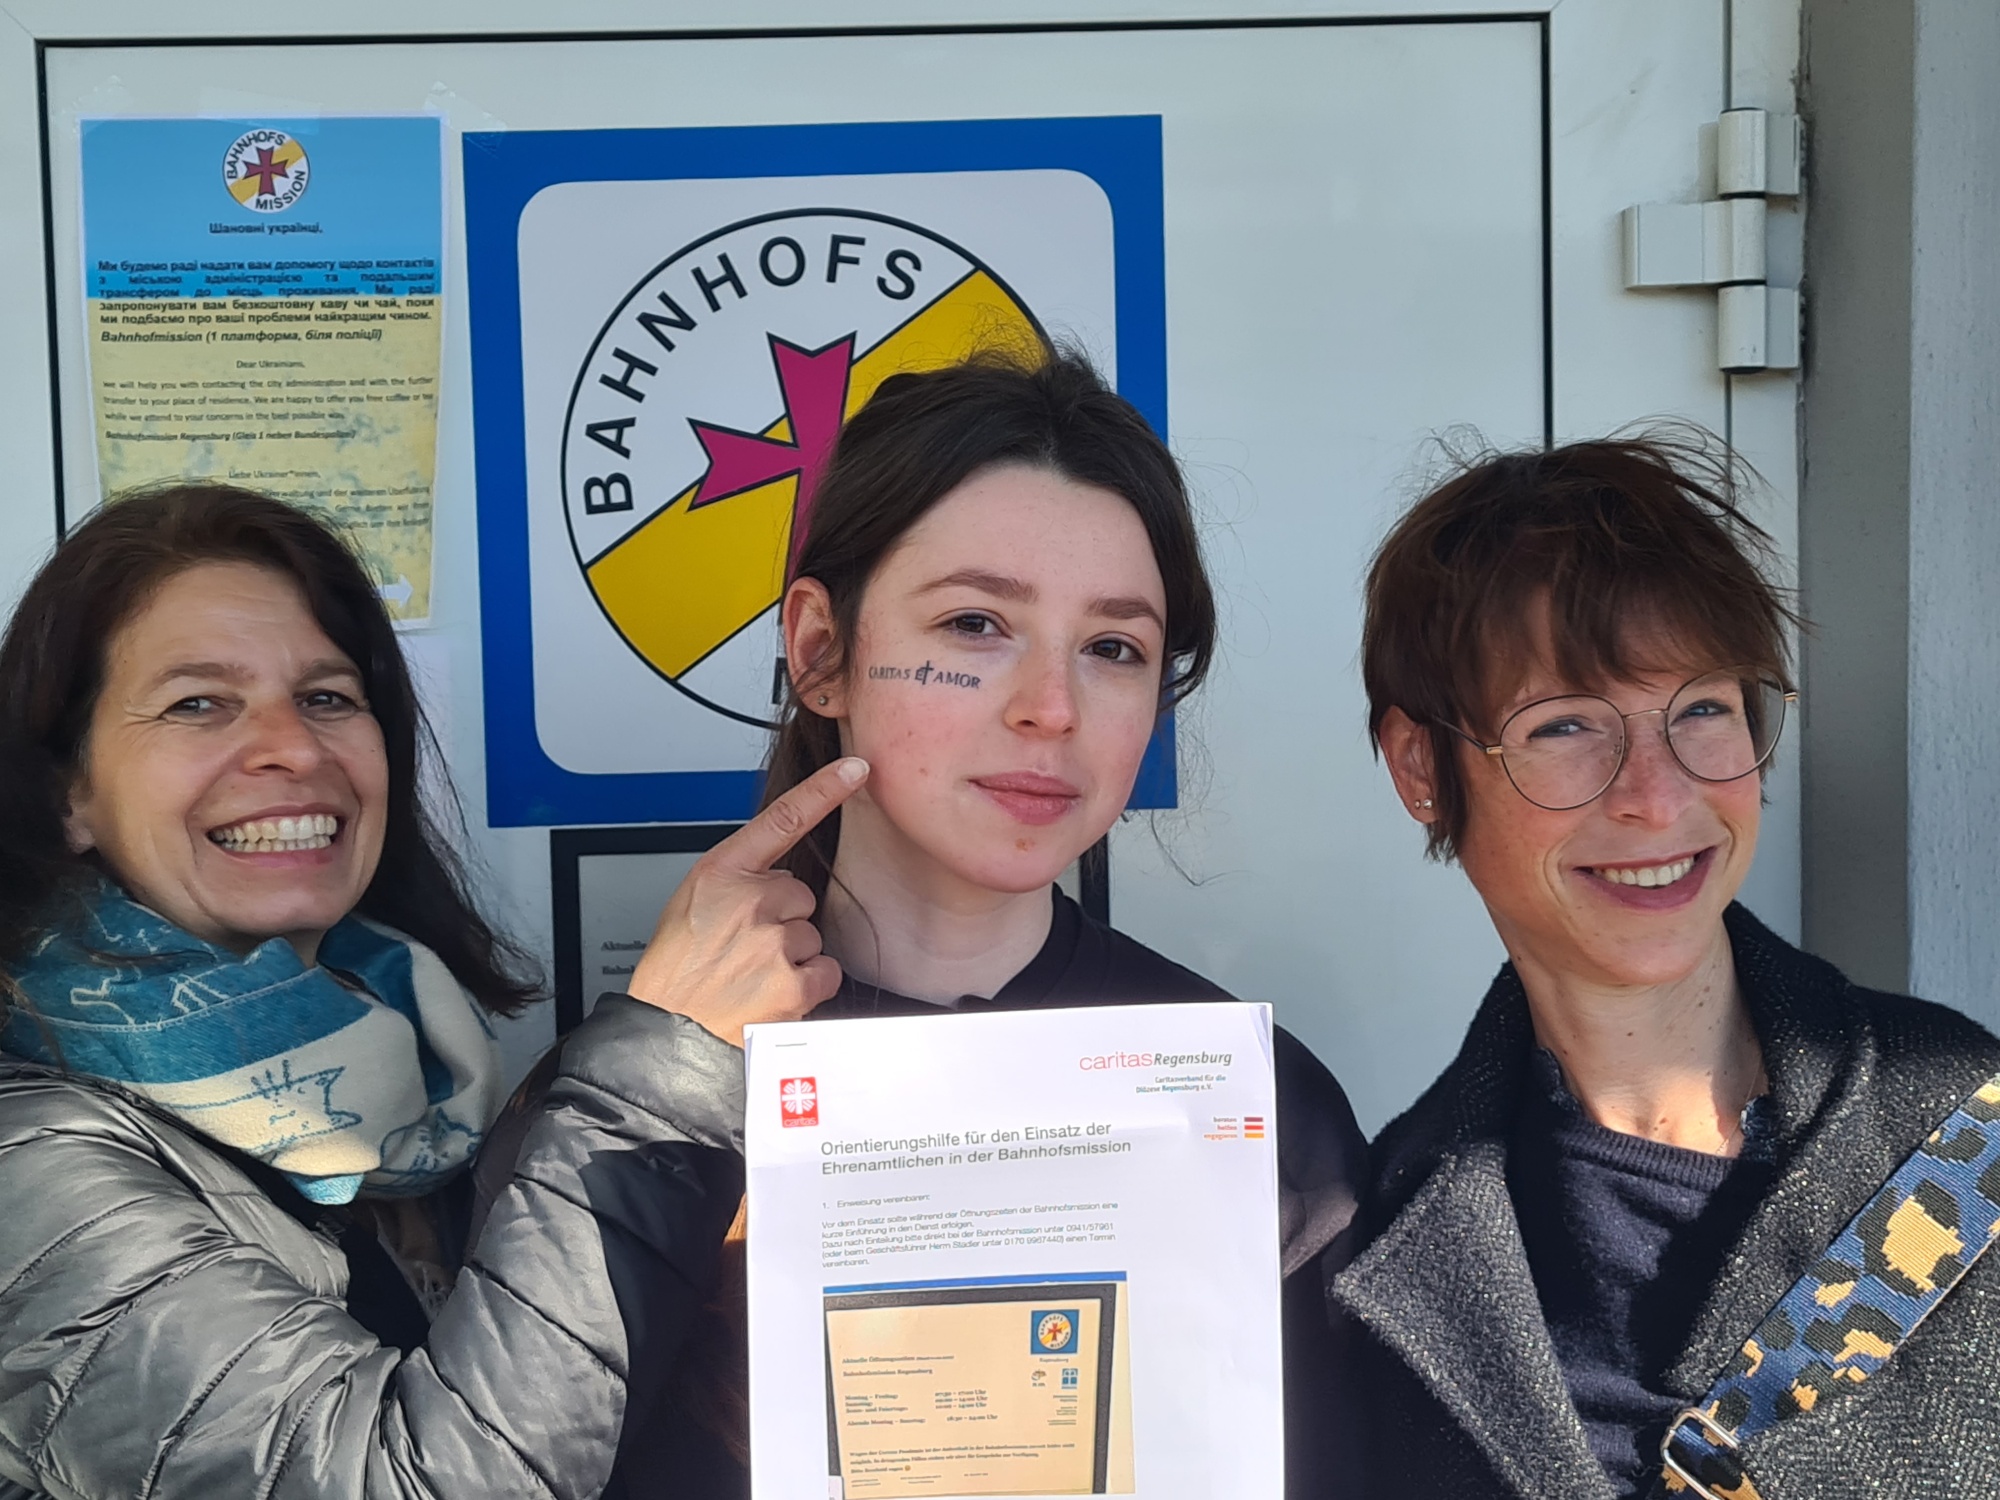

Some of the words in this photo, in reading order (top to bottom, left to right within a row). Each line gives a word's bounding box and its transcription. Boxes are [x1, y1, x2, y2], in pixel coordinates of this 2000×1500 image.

[227, 131, 285, 179] BAHNHOFS
[255, 170, 306, 210] MISSION
[209, 223, 265, 234] Шановні
[121, 260, 167, 273] будемо
[171, 260, 198, 272] раді
[201, 261, 244, 270] надати
[248, 261, 271, 270] вам
[275, 260, 336, 271] допомогу
[376, 257, 435, 268] контактів
[194, 289, 211, 298] до
[99, 301, 197, 313] запропонувати
[203, 301, 227, 310] вам
[232, 299, 314, 311] безкоштовну
[321, 300, 349, 311] каву
[354, 299, 369, 308] чи
[375, 298, 400, 309] чай,
[406, 298, 435, 307] поки
[100, 315, 117, 323] ми
[189, 315, 212, 325] про
[215, 313, 245, 323] ваші
[248, 313, 311, 325] проблеми
[314, 311, 386, 323] найкращим
[389, 311, 431, 321] чином.
[101, 330, 203, 342] Bahnhofmission
[206, 331, 217, 344] (1
[221, 330, 301, 343] платформа,
[305, 329, 332, 340] біля
[336, 328, 382, 341] поліції)
[236, 360, 256, 369] Dear
[584, 234, 923, 515] BAHNHOFS
[137, 381, 157, 390] help
[161, 382, 177, 390] you
[202, 380, 246, 390] contacting
[249, 380, 263, 388] the
[286, 379, 346, 387] administration
[350, 378, 365, 386] and
[139, 397, 148, 405] to
[151, 398, 170, 407] your
[180, 432, 230, 442] Regensburg
[868, 666, 911, 680] CARITAS
[933, 671, 982, 689] AMOR
[1155, 1075, 1204, 1084] Caritasverband
[1215, 1074, 1227, 1082] die
[1162, 1084, 1200, 1093] Regensburg
[821, 1132, 960, 1155] Orientierungshilfe
[964, 1131, 986, 1145] für
[990, 1129, 1020, 1143] den
[1025, 1124, 1082, 1141] Einsatz
[1086, 1122, 1112, 1136] der
[822, 1155, 944, 1175] Ehrenamtlichen
[948, 1152, 962, 1165] in
[967, 1150, 994, 1163] der
[998, 1140, 1131, 1161] Bahnhofsmission
[837, 1198, 881, 1208] Einweisung
[822, 1221, 835, 1229] Vor
[837, 1219, 855, 1228] dem
[857, 1217, 885, 1226] Einsatz
[887, 1215, 908, 1224] sollte
[908, 1212, 943, 1222] während
[945, 1211, 958, 1219] der
[1019, 1206, 1032, 1214] der
[1034, 1202, 1100, 1213] Bahnhofsmission
[821, 1231, 843, 1239] kurze
[845, 1227, 887, 1237] Einführung
[888, 1225, 896, 1233] in
[897, 1224, 913, 1233] den
[914, 1222, 939, 1232] Dienst
[940, 1220, 974, 1230] erfolgen.
[822, 1240, 842, 1249] Dazu
[844, 1238, 864, 1247] nach
[905, 1233, 922, 1242] bitte
[924, 1232, 946, 1240] direkt
[947, 1230, 960, 1239] bei
[961, 1230, 974, 1238] der
[976, 1227, 1042, 1237] Bahnhofsmission
[1044, 1226, 1064, 1234] unter
[822, 1250, 842, 1260] (oder
[844, 1248, 864, 1257] beim
[982, 1239, 1002, 1247] unter
[1004, 1237, 1024, 1246] 0170
[1065, 1235, 1087, 1243] einen
[1089, 1233, 1116, 1242] Termin
[822, 1259, 870, 1268] vereinbaren.
